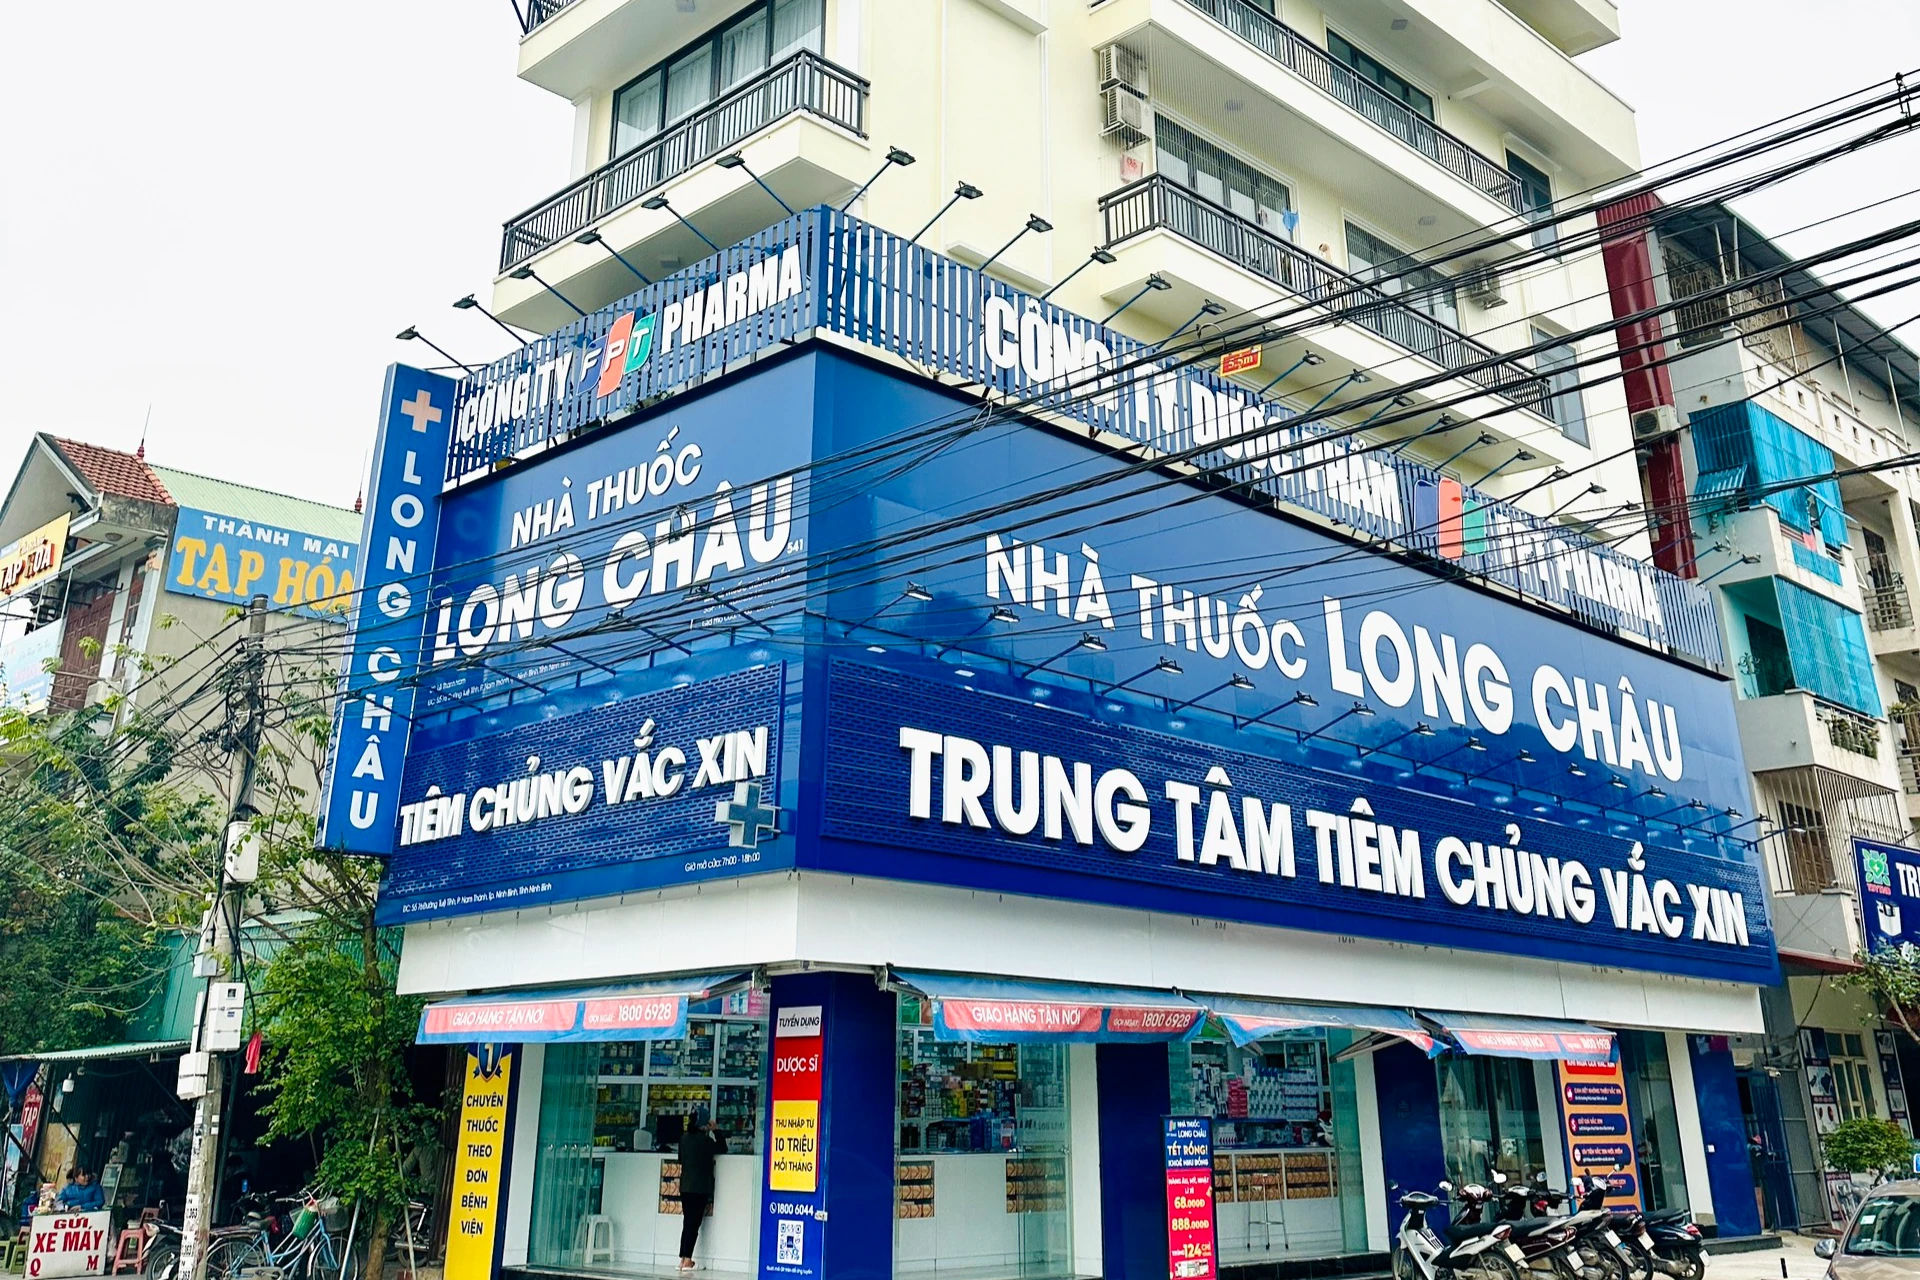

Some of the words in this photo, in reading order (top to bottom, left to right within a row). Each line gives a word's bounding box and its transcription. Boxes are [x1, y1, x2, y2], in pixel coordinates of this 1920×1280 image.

[460, 373, 530, 443] CÔNG
[536, 352, 574, 412] TY
[661, 244, 803, 354] PHARMA
[984, 295, 1114, 412] CÔNG
[1552, 536, 1664, 629] PHARMA
[510, 476, 575, 549] NHÀ
[586, 426, 703, 520] THUỐC
[203, 515, 290, 547] THÀNH
[303, 537, 349, 560] MAI
[377, 450, 424, 618] LONG
[787, 539, 804, 554] 541
[176, 536, 265, 597] TẠP
[273, 556, 355, 614] HÓA
[432, 551, 586, 667] LONG
[602, 475, 794, 609] CHÂU
[986, 533, 1116, 631] NHÀ
[1130, 583, 1308, 680] THUỐC
[1323, 595, 1514, 735] LONG
[1531, 675, 1684, 782] CHÂU
[349, 645, 401, 829] CHÂU
[400, 785, 466, 846] TIÊM
[469, 755, 594, 832] CHỦNG
[602, 719, 687, 806] VẮC
[692, 726, 769, 789] XIN
[900, 726, 1151, 852] TRUNG
[1165, 765, 1296, 878] TÂM
[1306, 796, 1426, 899] TIÊM
[1435, 823, 1596, 924] CHỦNG
[1599, 841, 1684, 939] VẮC
[1686, 883, 1750, 947] XIN
[722, 855, 737, 867] 7h00
[741, 852, 761, 864] 18h00
[495, 889, 507, 899] Ninh
[529, 884, 540, 894] Ninh
[452, 1011, 477, 1027] GIAO
[477, 1008, 504, 1026] HÀNG
[617, 1004, 642, 1022] 1800
[643, 1003, 672, 1021] 6928
[971, 1006, 1001, 1023] GIAO
[1003, 1004, 1036, 1024] HÀNG
[1038, 1006, 1061, 1029] TẬN
[1141, 1012, 1164, 1028] 1800
[1165, 1013, 1191, 1029] 6928
[484, 1042, 494, 1072] 1
[776, 1056, 807, 1077] DƯỢC
[808, 1054, 819, 1072] SĨ
[466, 1091, 504, 1108] CHUYÊN
[22, 1106, 38, 1131] TẠP
[466, 1115, 498, 1133] THUỐC
[775, 1118, 787, 1128] THU
[1177, 1130, 1192, 1138] LONG
[1193, 1128, 1207, 1138] CHÂU
[467, 1144, 493, 1158] THEO
[775, 1137, 785, 1152] 10
[787, 1135, 814, 1157] TRIỆU
[1167, 1140, 1181, 1156] TẾT
[466, 1168, 488, 1183] ĐƠN
[461, 1192, 488, 1212] BỆNH
[777, 1202, 794, 1215] 1800
[794, 1203, 814, 1217] 6044
[53, 1213, 90, 1230] GỬI
[461, 1218, 483, 1238] VIỆN
[33, 1232, 58, 1253] XE
[62, 1225, 105, 1252] MÁY
[1183, 1243, 1202, 1258] 124
[30, 1258, 42, 1277] Q
[86, 1254, 99, 1271] M
